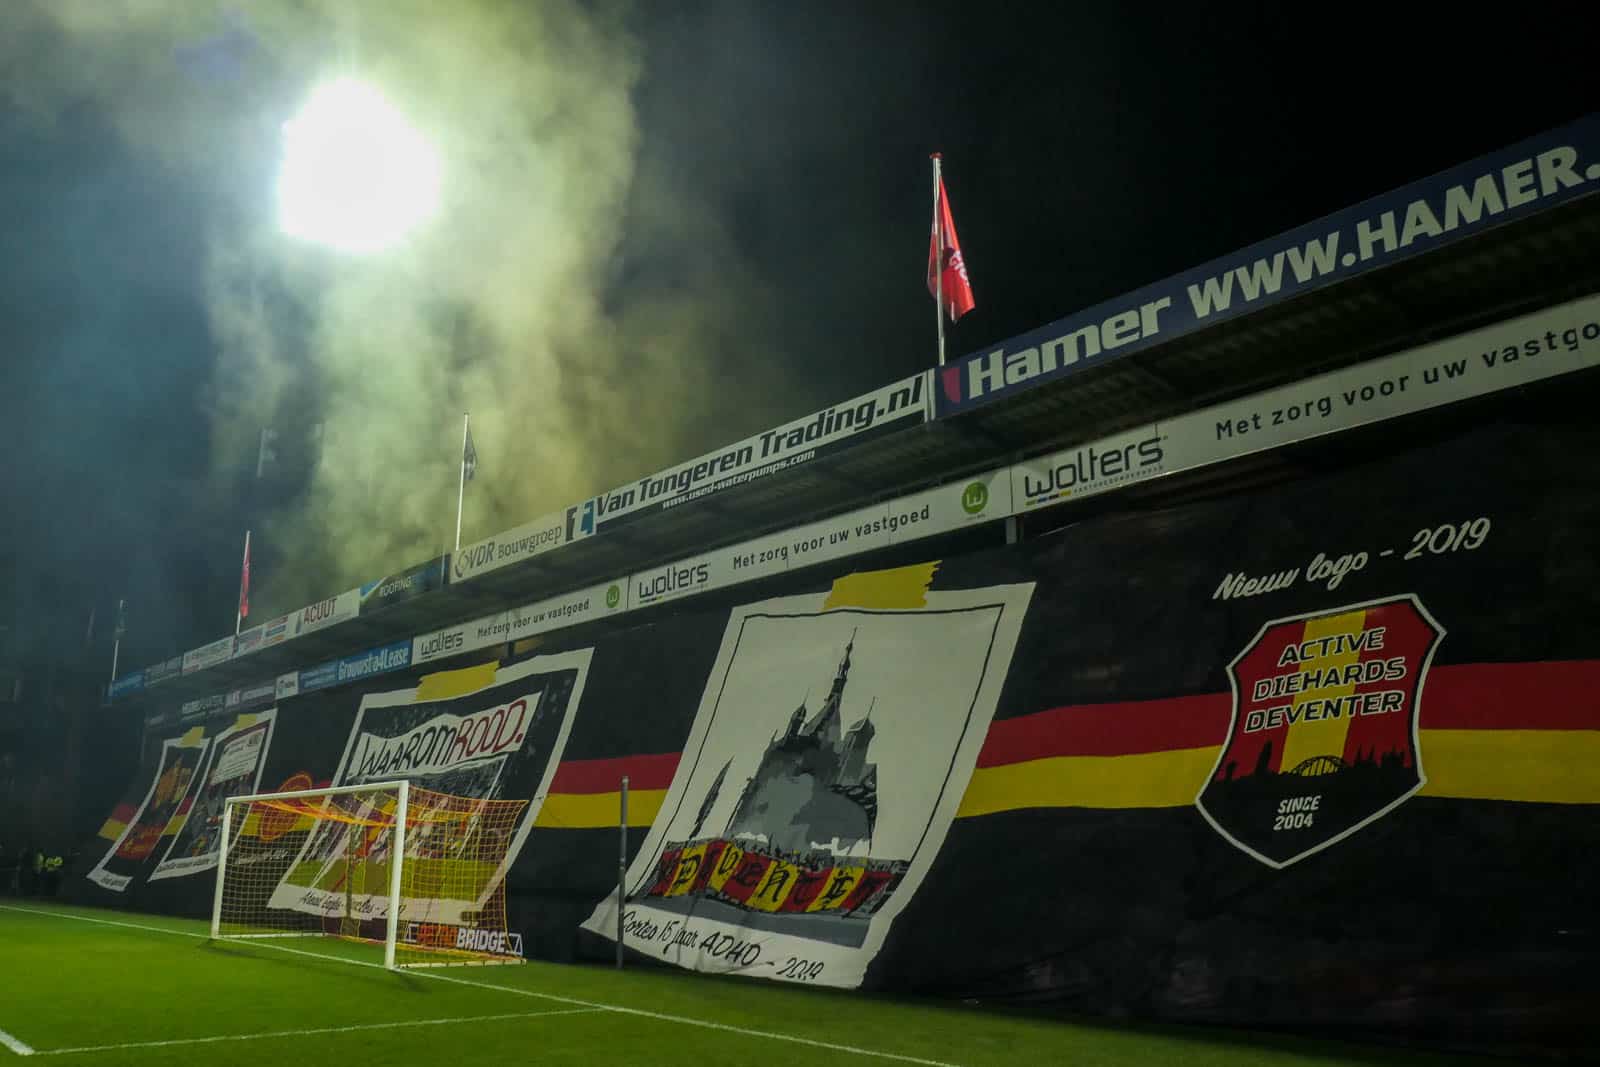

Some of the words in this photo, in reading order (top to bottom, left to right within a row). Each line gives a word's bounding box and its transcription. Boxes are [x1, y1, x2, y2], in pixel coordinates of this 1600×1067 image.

[965, 295, 1172, 400] Hamer
[595, 494, 635, 517] Van
[638, 446, 753, 503] Tongeren
[759, 375, 924, 457] Trading.nl
[1024, 433, 1165, 500] wolters
[1215, 413, 1264, 441] Met
[1271, 396, 1334, 427] zorg
[1343, 373, 1411, 407] voor
[1423, 354, 1469, 386] uw
[662, 449, 816, 510] www.used-waterpumps.com
[468, 540, 496, 569] VDR
[497, 525, 562, 559] Bouwgroep
[638, 562, 710, 599] wolters
[733, 553, 755, 571] Met
[759, 545, 789, 562] zorg
[792, 538, 826, 555] voor
[829, 530, 849, 546] uw
[855, 504, 931, 537] vastgoed
[1211, 567, 1300, 601] Nieuw
[1305, 549, 1369, 591] logo
[1403, 517, 1491, 561] 2019
[303, 598, 337, 625] ACUUT
[420, 630, 464, 656] wolters
[477, 626, 491, 640] Met
[493, 622, 511, 635] zorg
[513, 616, 531, 630] voor
[533, 612, 545, 624] uw
[548, 598, 590, 619] vastgoed
[1277, 627, 1386, 668] ACTIVE
[1251, 656, 1407, 703] DIEHARDS
[1243, 690, 1406, 735] DEVENTER
[1273, 812, 1315, 831] 2004
[1277, 795, 1322, 814] SINCE
[456, 926, 506, 953] BRIDGE
[659, 919, 678, 942] 15
[663, 926, 698, 954] jaar
[776, 956, 825, 981] 2019
